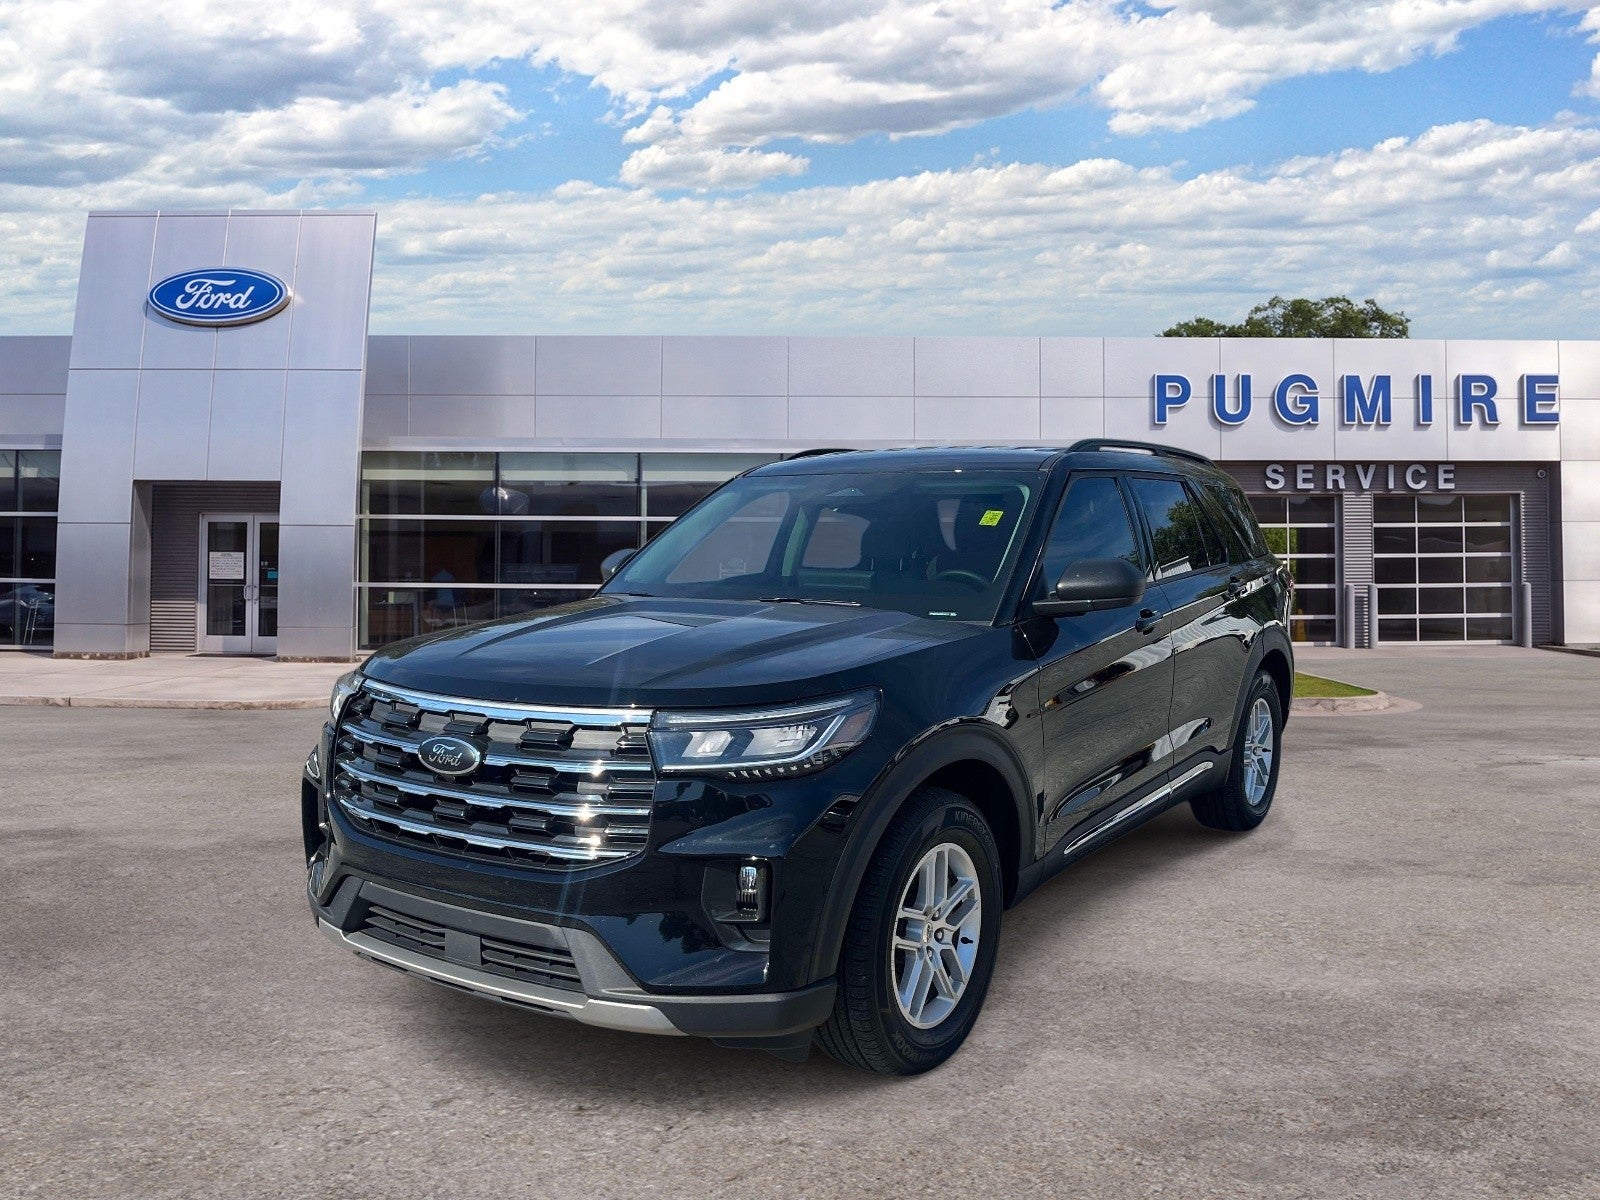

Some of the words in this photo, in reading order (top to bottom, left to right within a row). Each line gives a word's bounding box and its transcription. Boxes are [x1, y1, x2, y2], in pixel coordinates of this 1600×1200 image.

[175, 278, 255, 309] Ford
[1153, 373, 1560, 425] PUGMIRE
[1265, 464, 1456, 490] SERVICE
[428, 743, 463, 767] Ford
